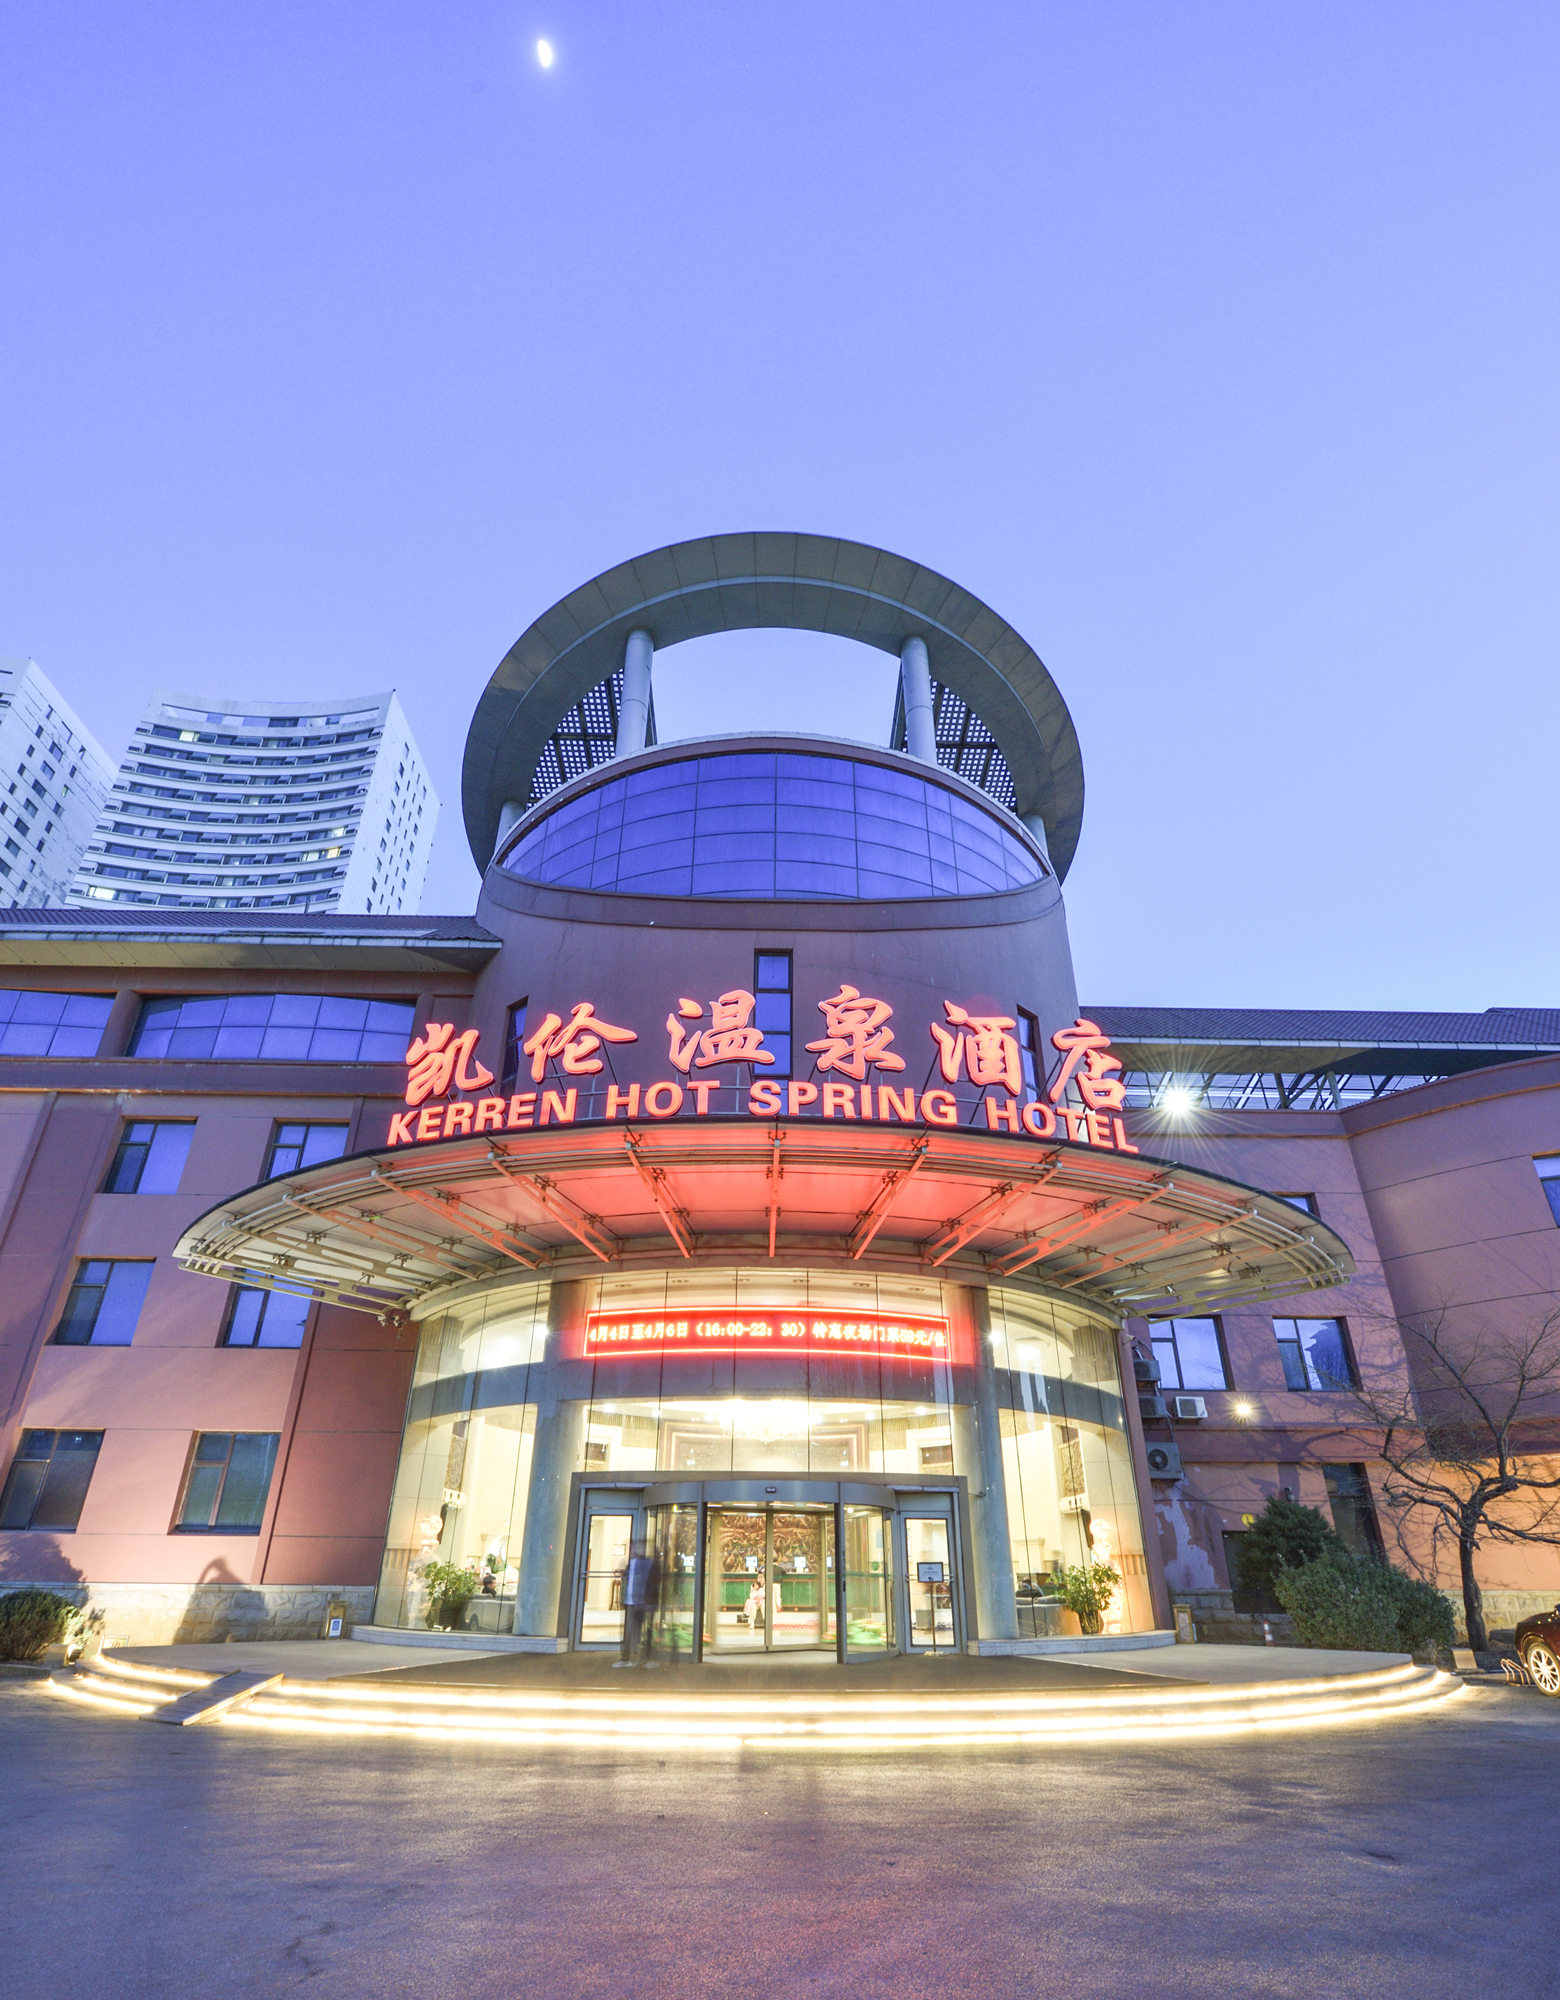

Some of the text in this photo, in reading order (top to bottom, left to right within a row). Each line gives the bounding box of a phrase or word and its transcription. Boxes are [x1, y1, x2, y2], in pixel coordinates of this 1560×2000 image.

[405, 984, 1127, 1112] 凯伦温泉酒店
[386, 1080, 1139, 1155] KERREN HOT SPRING HOTEL
